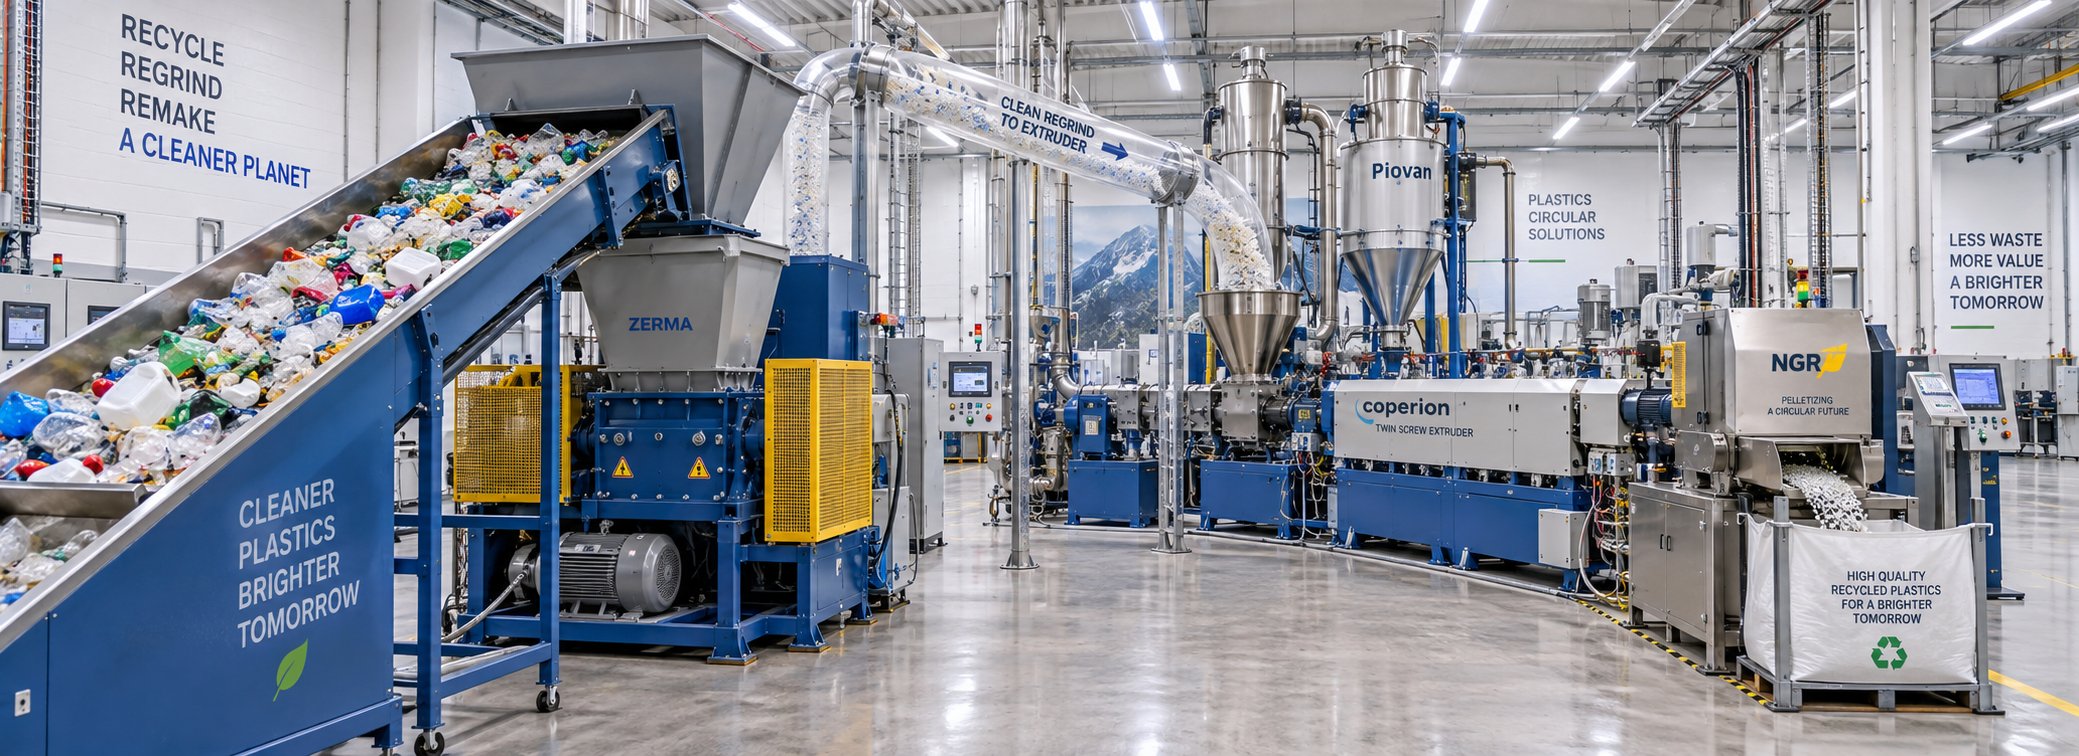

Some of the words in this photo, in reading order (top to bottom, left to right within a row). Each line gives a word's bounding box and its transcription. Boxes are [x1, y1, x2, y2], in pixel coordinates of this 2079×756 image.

[121, 13, 225, 67] RECYCLE
[121, 50, 223, 100] REGRIND
[120, 88, 216, 135] REMAKE
[1001, 96, 1041, 120] CLEAN
[1043, 111, 1095, 138] REGRIND
[1001, 113, 1019, 130] TO
[1021, 120, 1088, 154] EXTRUDER
[119, 127, 135, 154] A
[142, 132, 238, 175] CLEANER
[243, 154, 311, 189] PLANET
[1372, 163, 1432, 180] Piovan
[1528, 194, 1592, 206] PLASTICS
[1528, 211, 1596, 223] CIRCULAR
[1528, 228, 1605, 240] SOLUTIONS
[1949, 233, 1986, 247] LESS
[1989, 233, 2043, 247] WASTE
[1949, 254, 1993, 268] MORE
[1996, 254, 2044, 268] VALUE
[1950, 275, 1961, 290] A
[1965, 275, 2043, 290] BRIGHTER
[1949, 295, 2044, 310] TOMORROW
[628, 317, 694, 331] ZERMA
[1771, 353, 1822, 372] NGR
[1362, 397, 1450, 418] coperion
[1781, 396, 1834, 405] PELLETIZING
[1767, 407, 1774, 416] A
[1775, 407, 1816, 416] CIRCULAR
[1817, 407, 1850, 416] FUTURE
[1375, 423, 1397, 433] TWIN
[1398, 425, 1427, 435] SCREW
[1428, 426, 1474, 438] EXTRUDER
[239, 478, 335, 529] CLEANER
[239, 514, 336, 570] PLASTICS
[238, 551, 340, 610] BRIGHTER
[1847, 571, 1875, 582] HIGH
[1878, 571, 1926, 582] QUALITY
[1831, 585, 1888, 596] RECYCLED
[1890, 585, 1942, 596] PLASTICS
[1841, 599, 1864, 610] FOR
[1866, 599, 1875, 610] A
[1877, 599, 1933, 610] BRIGHTER
[237, 579, 361, 649] TOMORROW
[1853, 613, 1922, 624] TOMORROW
